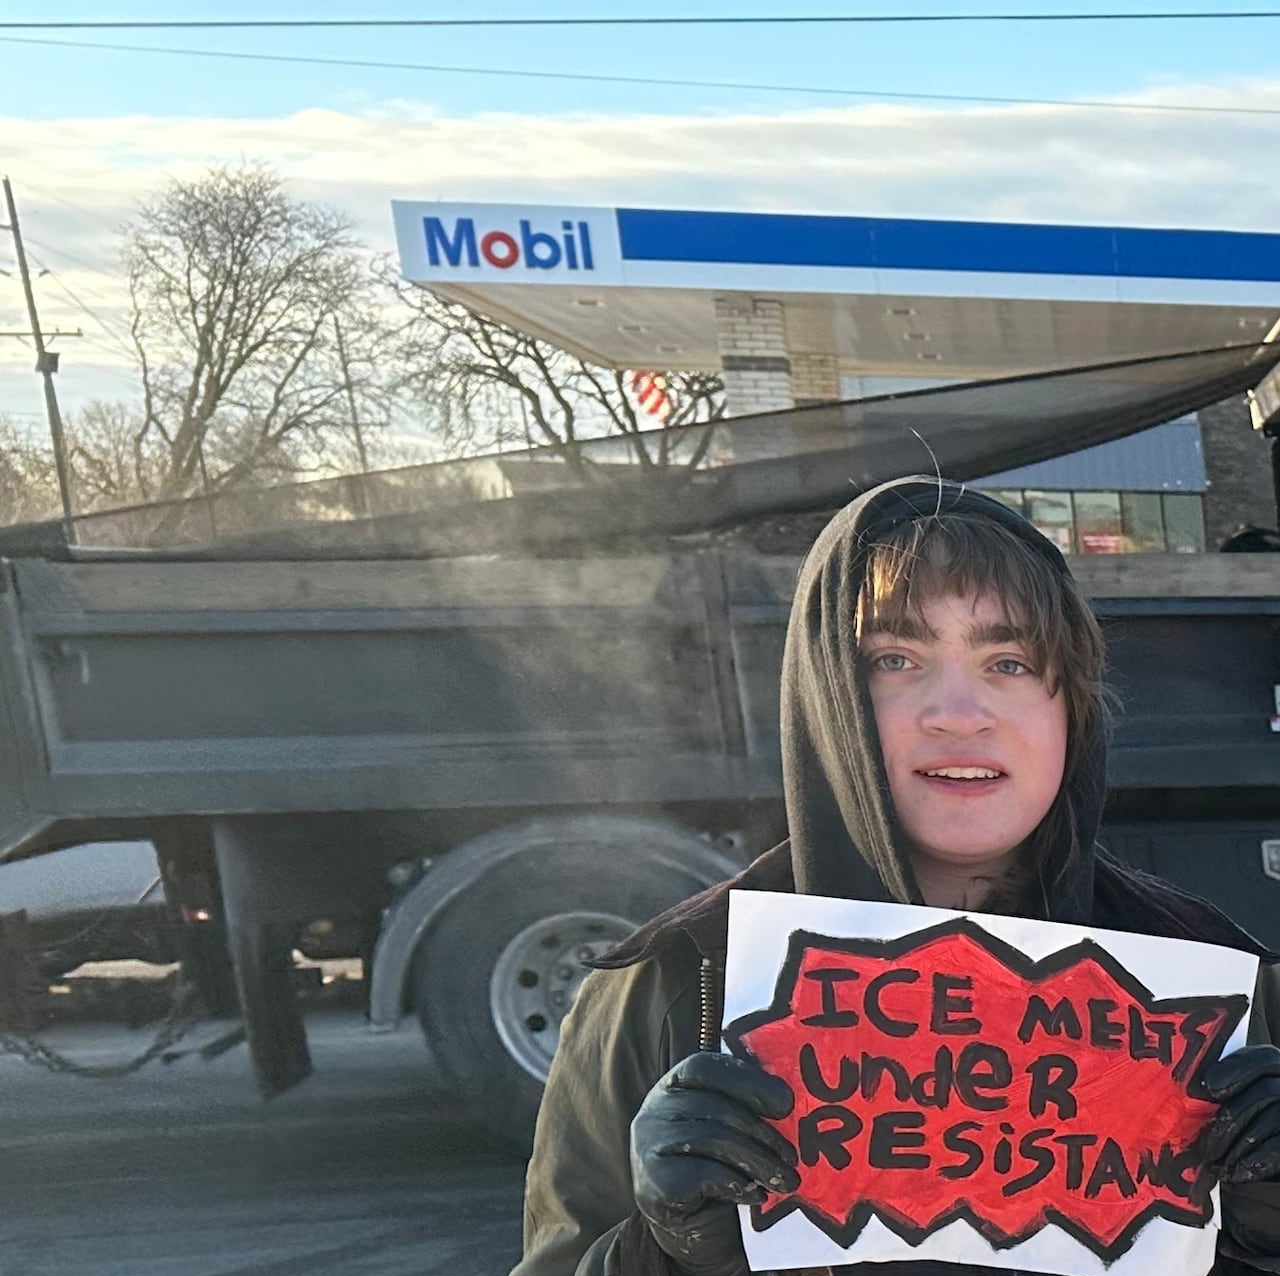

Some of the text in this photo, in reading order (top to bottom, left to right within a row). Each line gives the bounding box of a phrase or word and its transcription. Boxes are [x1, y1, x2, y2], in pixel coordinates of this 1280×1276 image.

[423, 216, 594, 271] Mobil
[800, 968, 1218, 1082] ICE MELTS
